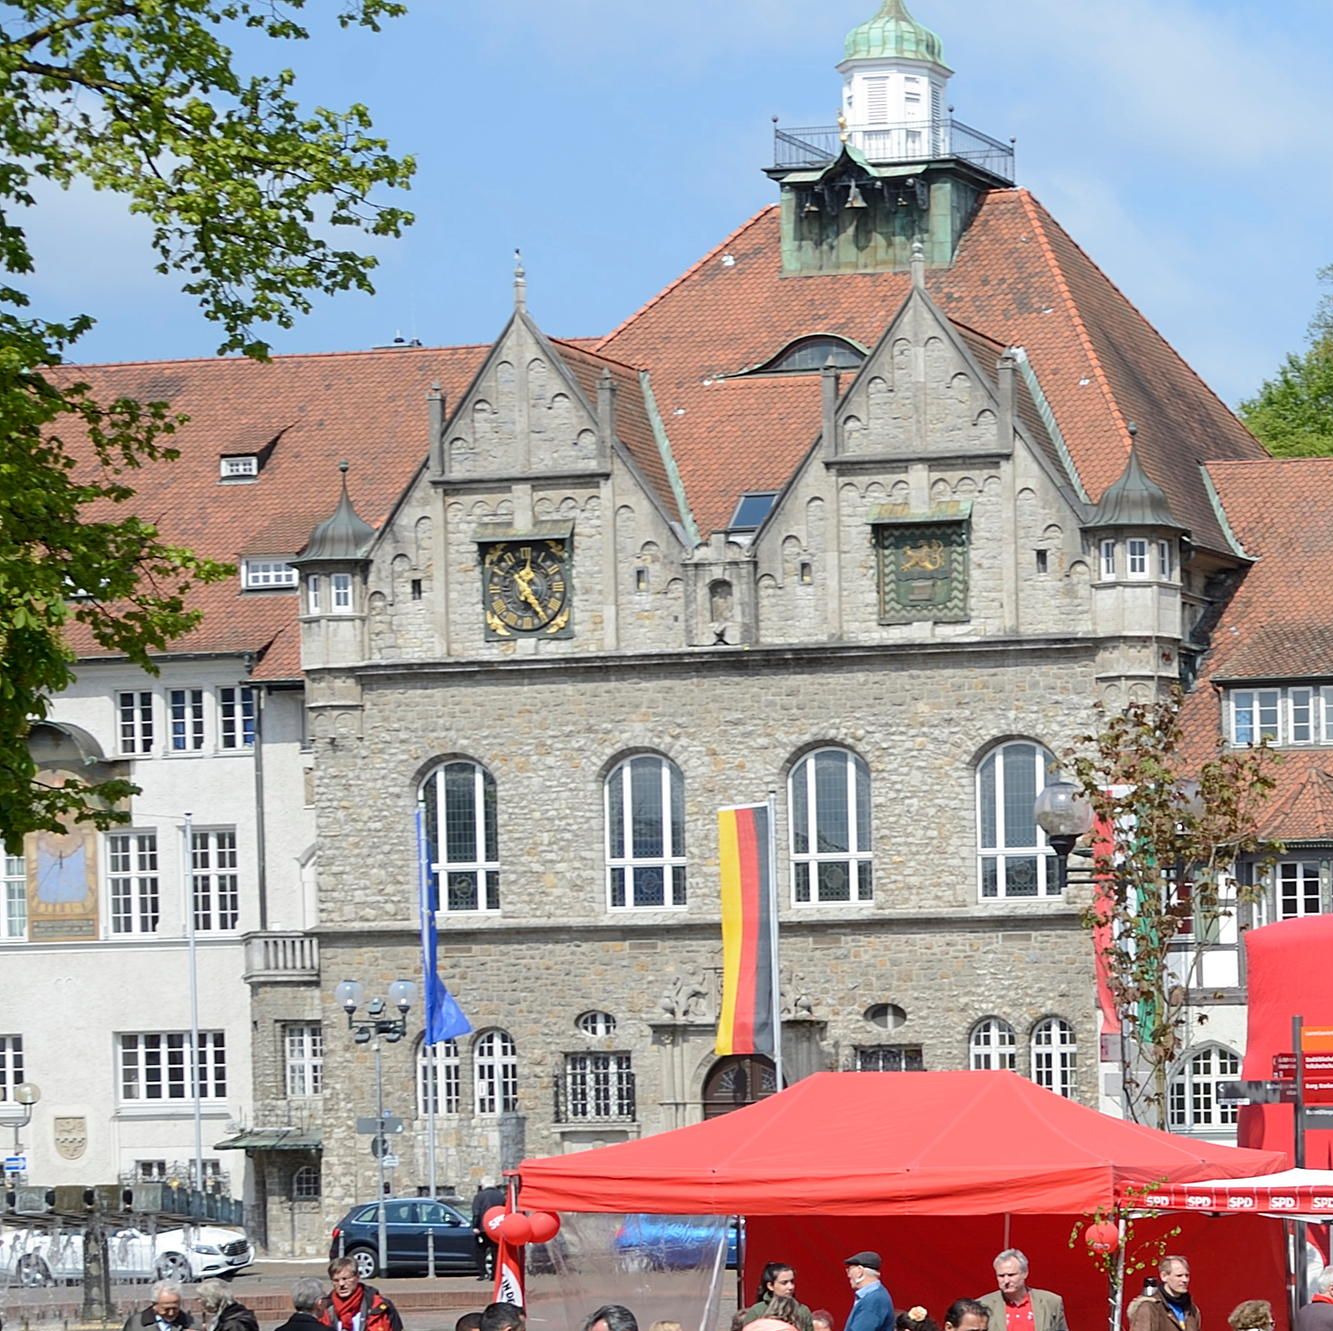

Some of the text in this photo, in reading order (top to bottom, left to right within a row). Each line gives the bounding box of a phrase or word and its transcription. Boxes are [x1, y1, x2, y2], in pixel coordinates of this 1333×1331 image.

[1186, 1197, 1211, 1207] SPD
[1228, 1197, 1253, 1208] SPD
[1271, 1198, 1295, 1208] SPD
